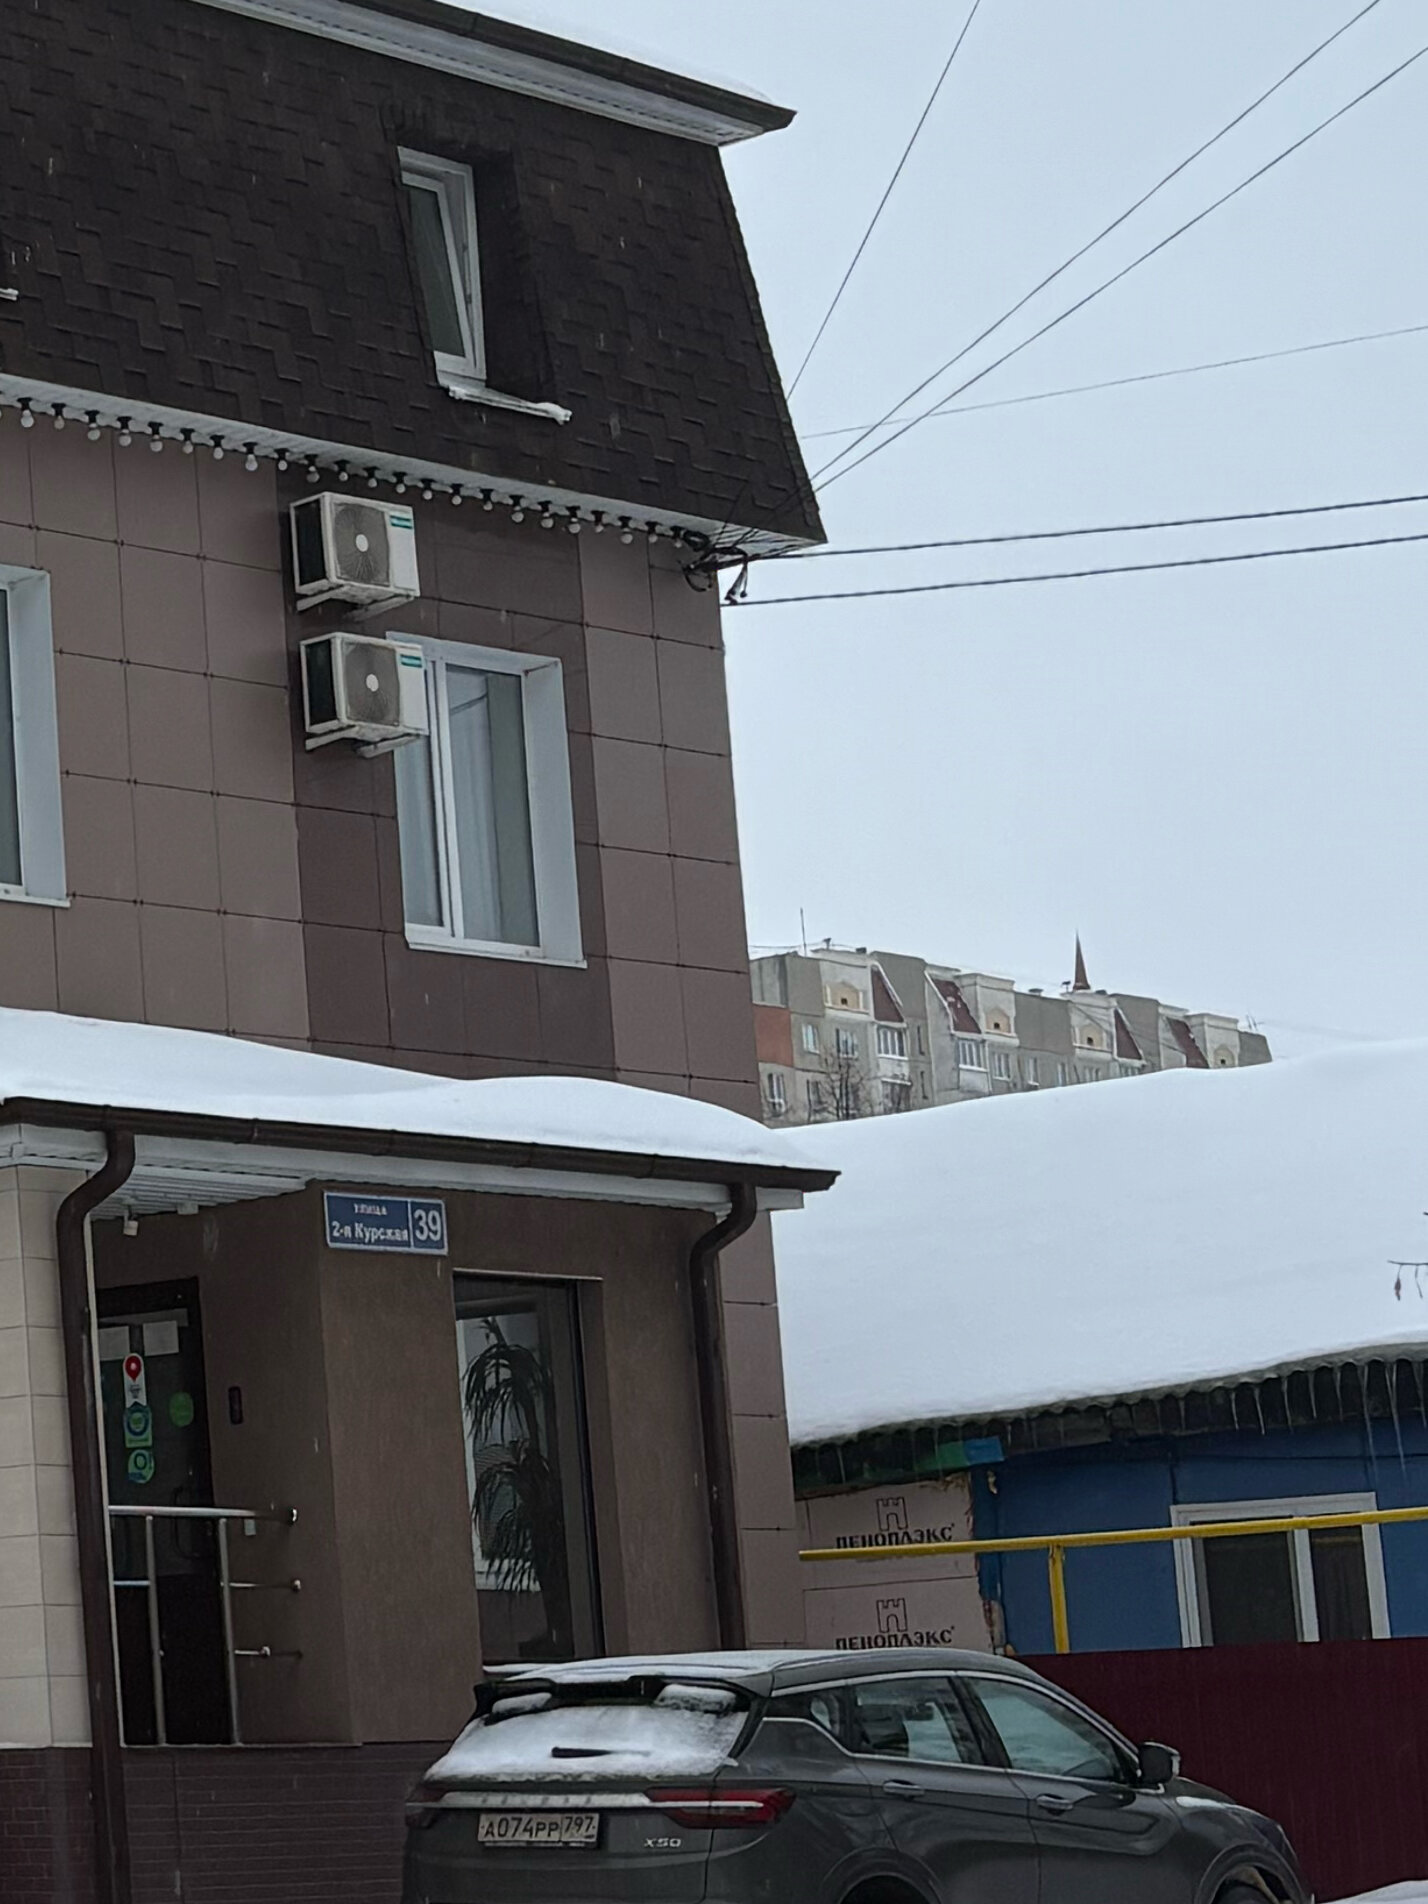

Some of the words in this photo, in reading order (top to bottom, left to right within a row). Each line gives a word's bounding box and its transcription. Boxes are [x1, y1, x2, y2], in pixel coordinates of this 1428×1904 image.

[354, 1222, 408, 1243] Курская
[413, 1209, 441, 1241] 39
[644, 1837, 682, 1848] X50
